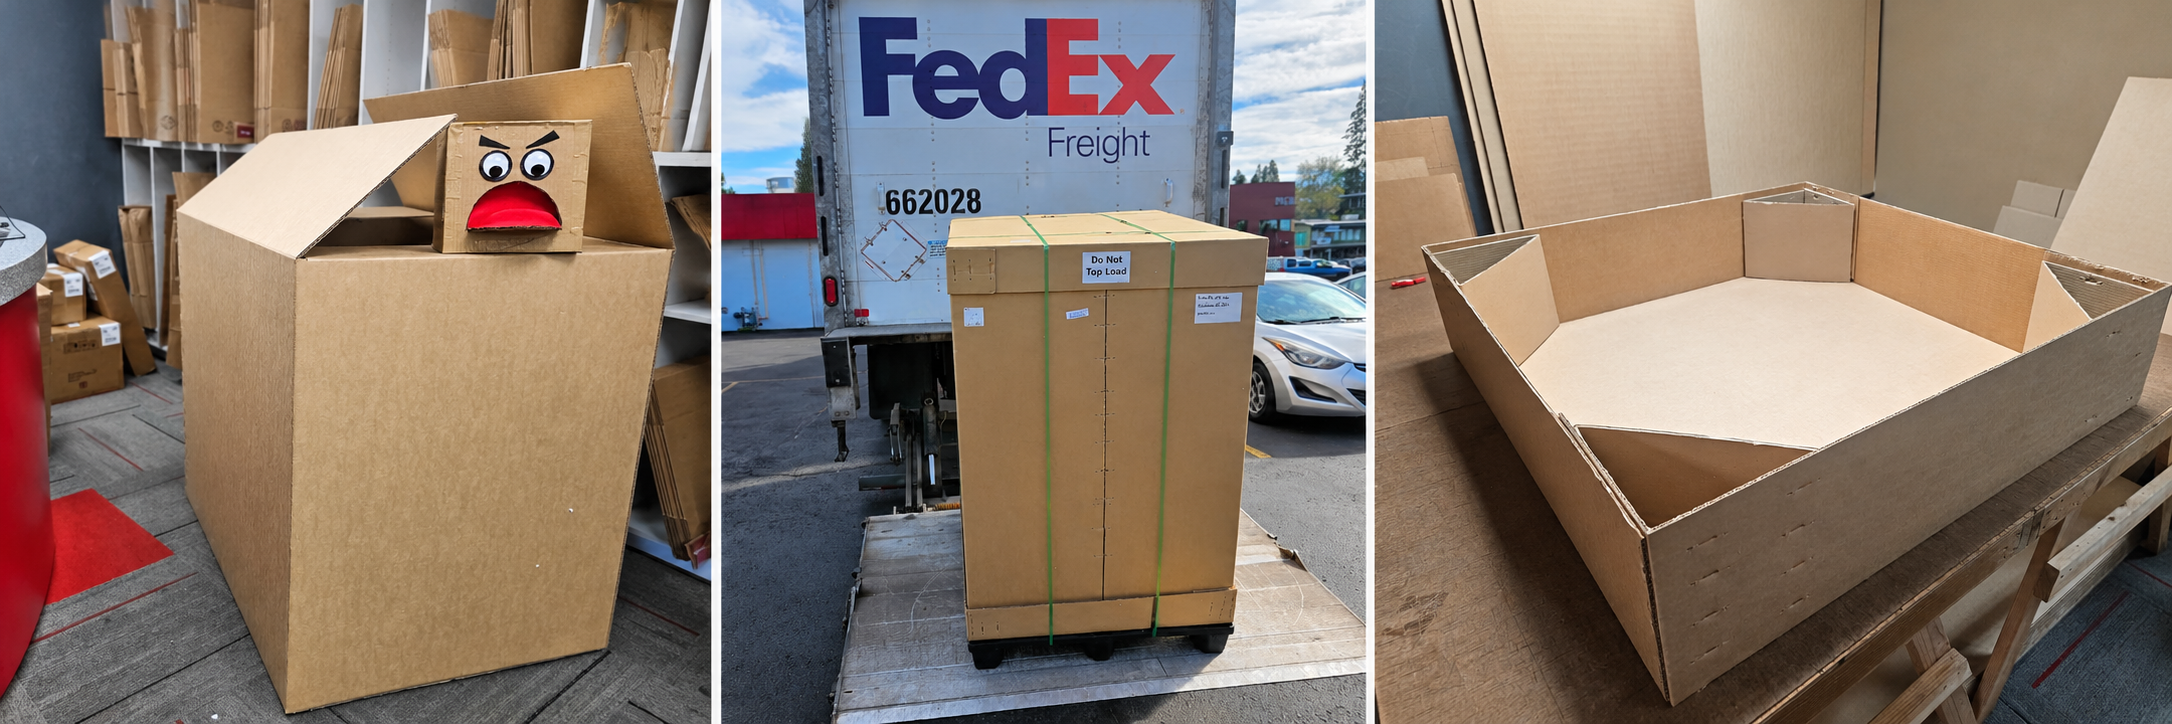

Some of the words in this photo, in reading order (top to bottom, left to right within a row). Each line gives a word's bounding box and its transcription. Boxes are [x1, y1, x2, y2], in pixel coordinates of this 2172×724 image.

[858, 17, 1176, 120] FedEx
[1048, 127, 1150, 163] Freight
[885, 188, 982, 215] 662028
[1086, 267, 1103, 277] Top
[1105, 267, 1127, 276] Load
[1091, 255, 1104, 264] Do
[1106, 255, 1123, 264] Not
